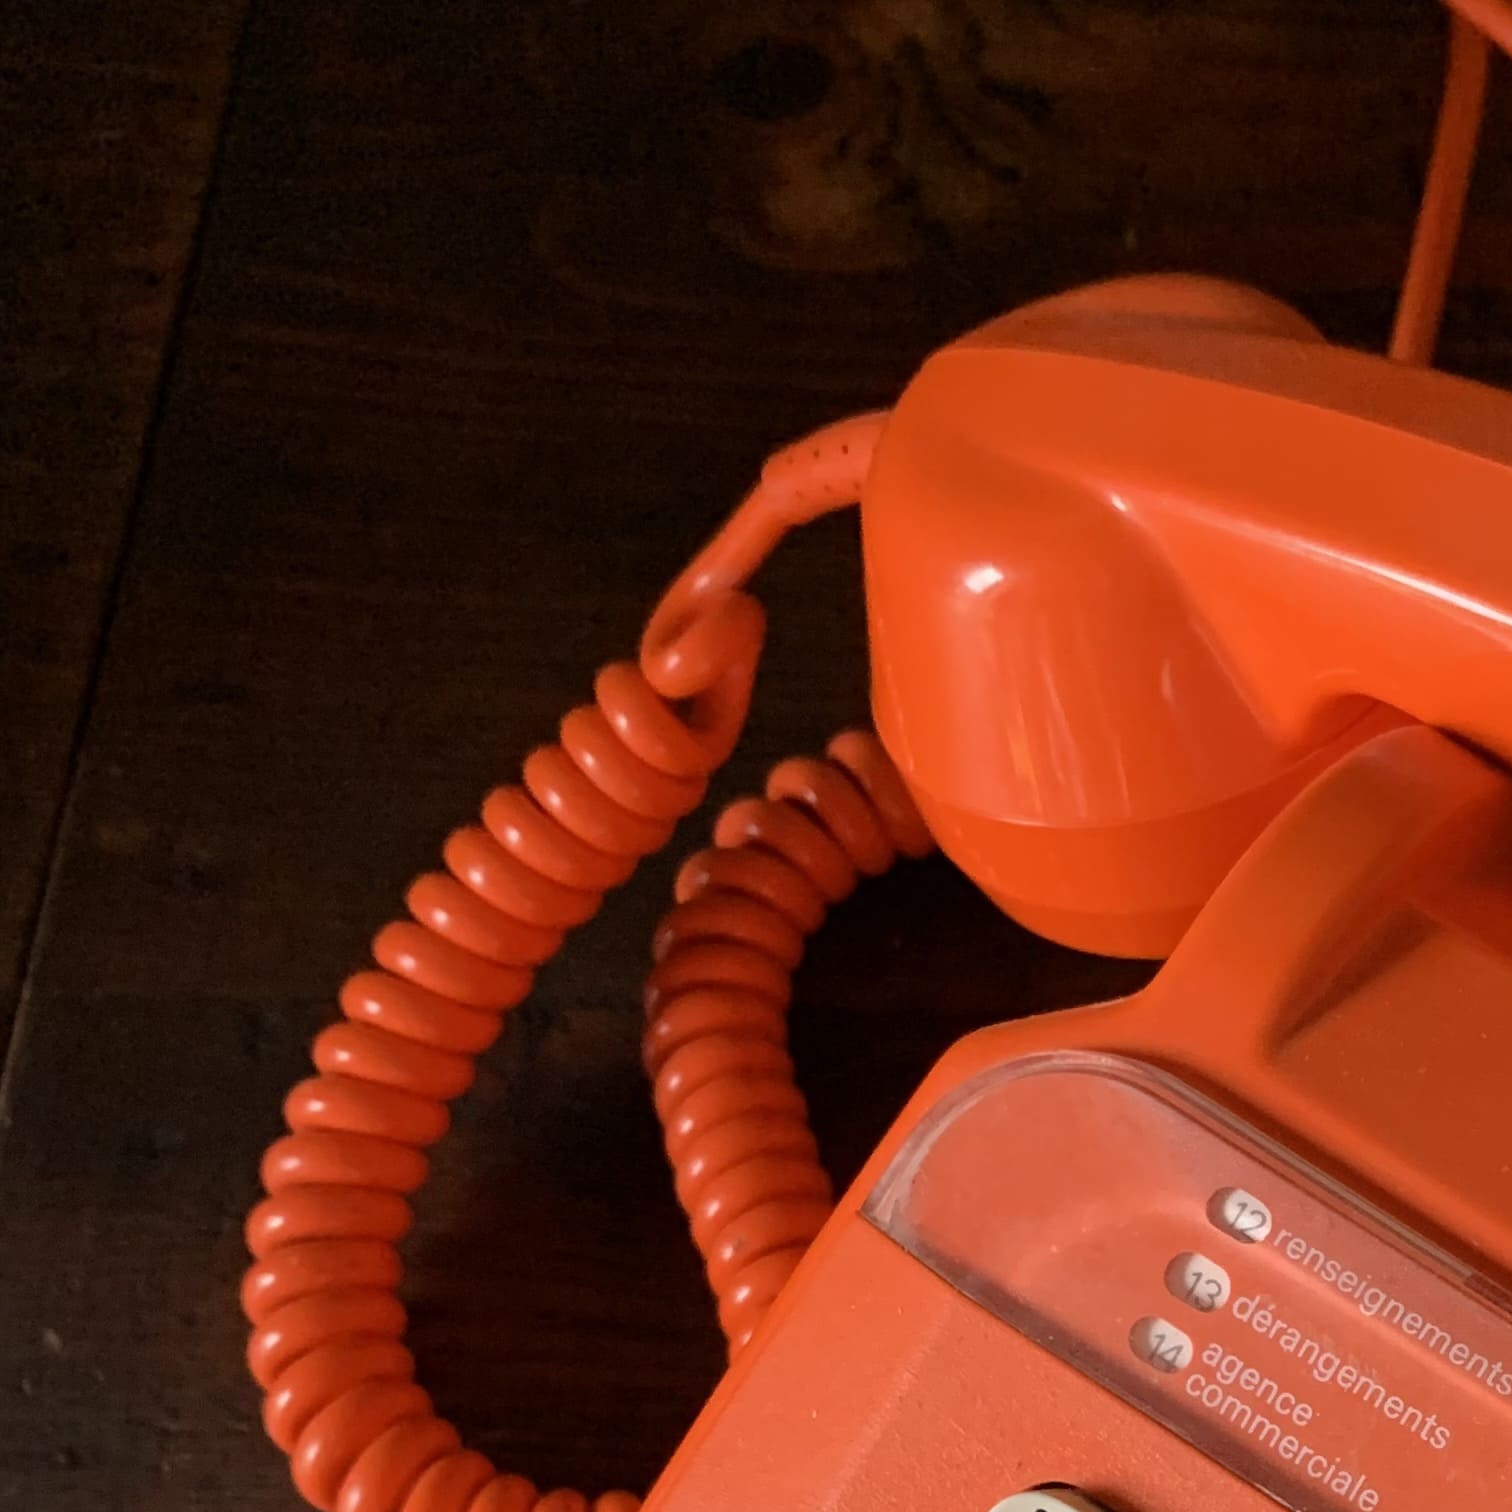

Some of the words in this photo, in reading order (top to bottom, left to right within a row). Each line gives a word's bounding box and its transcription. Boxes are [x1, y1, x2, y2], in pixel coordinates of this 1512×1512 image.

[1227, 1201, 1268, 1244] 12
[1148, 1333, 1185, 1371] 14
[1201, 1343, 1314, 1427] agence
[1185, 1271, 1223, 1312] 13
[1232, 1295, 1452, 1450] dérangements
[1185, 1374, 1380, 1512] commerciale
